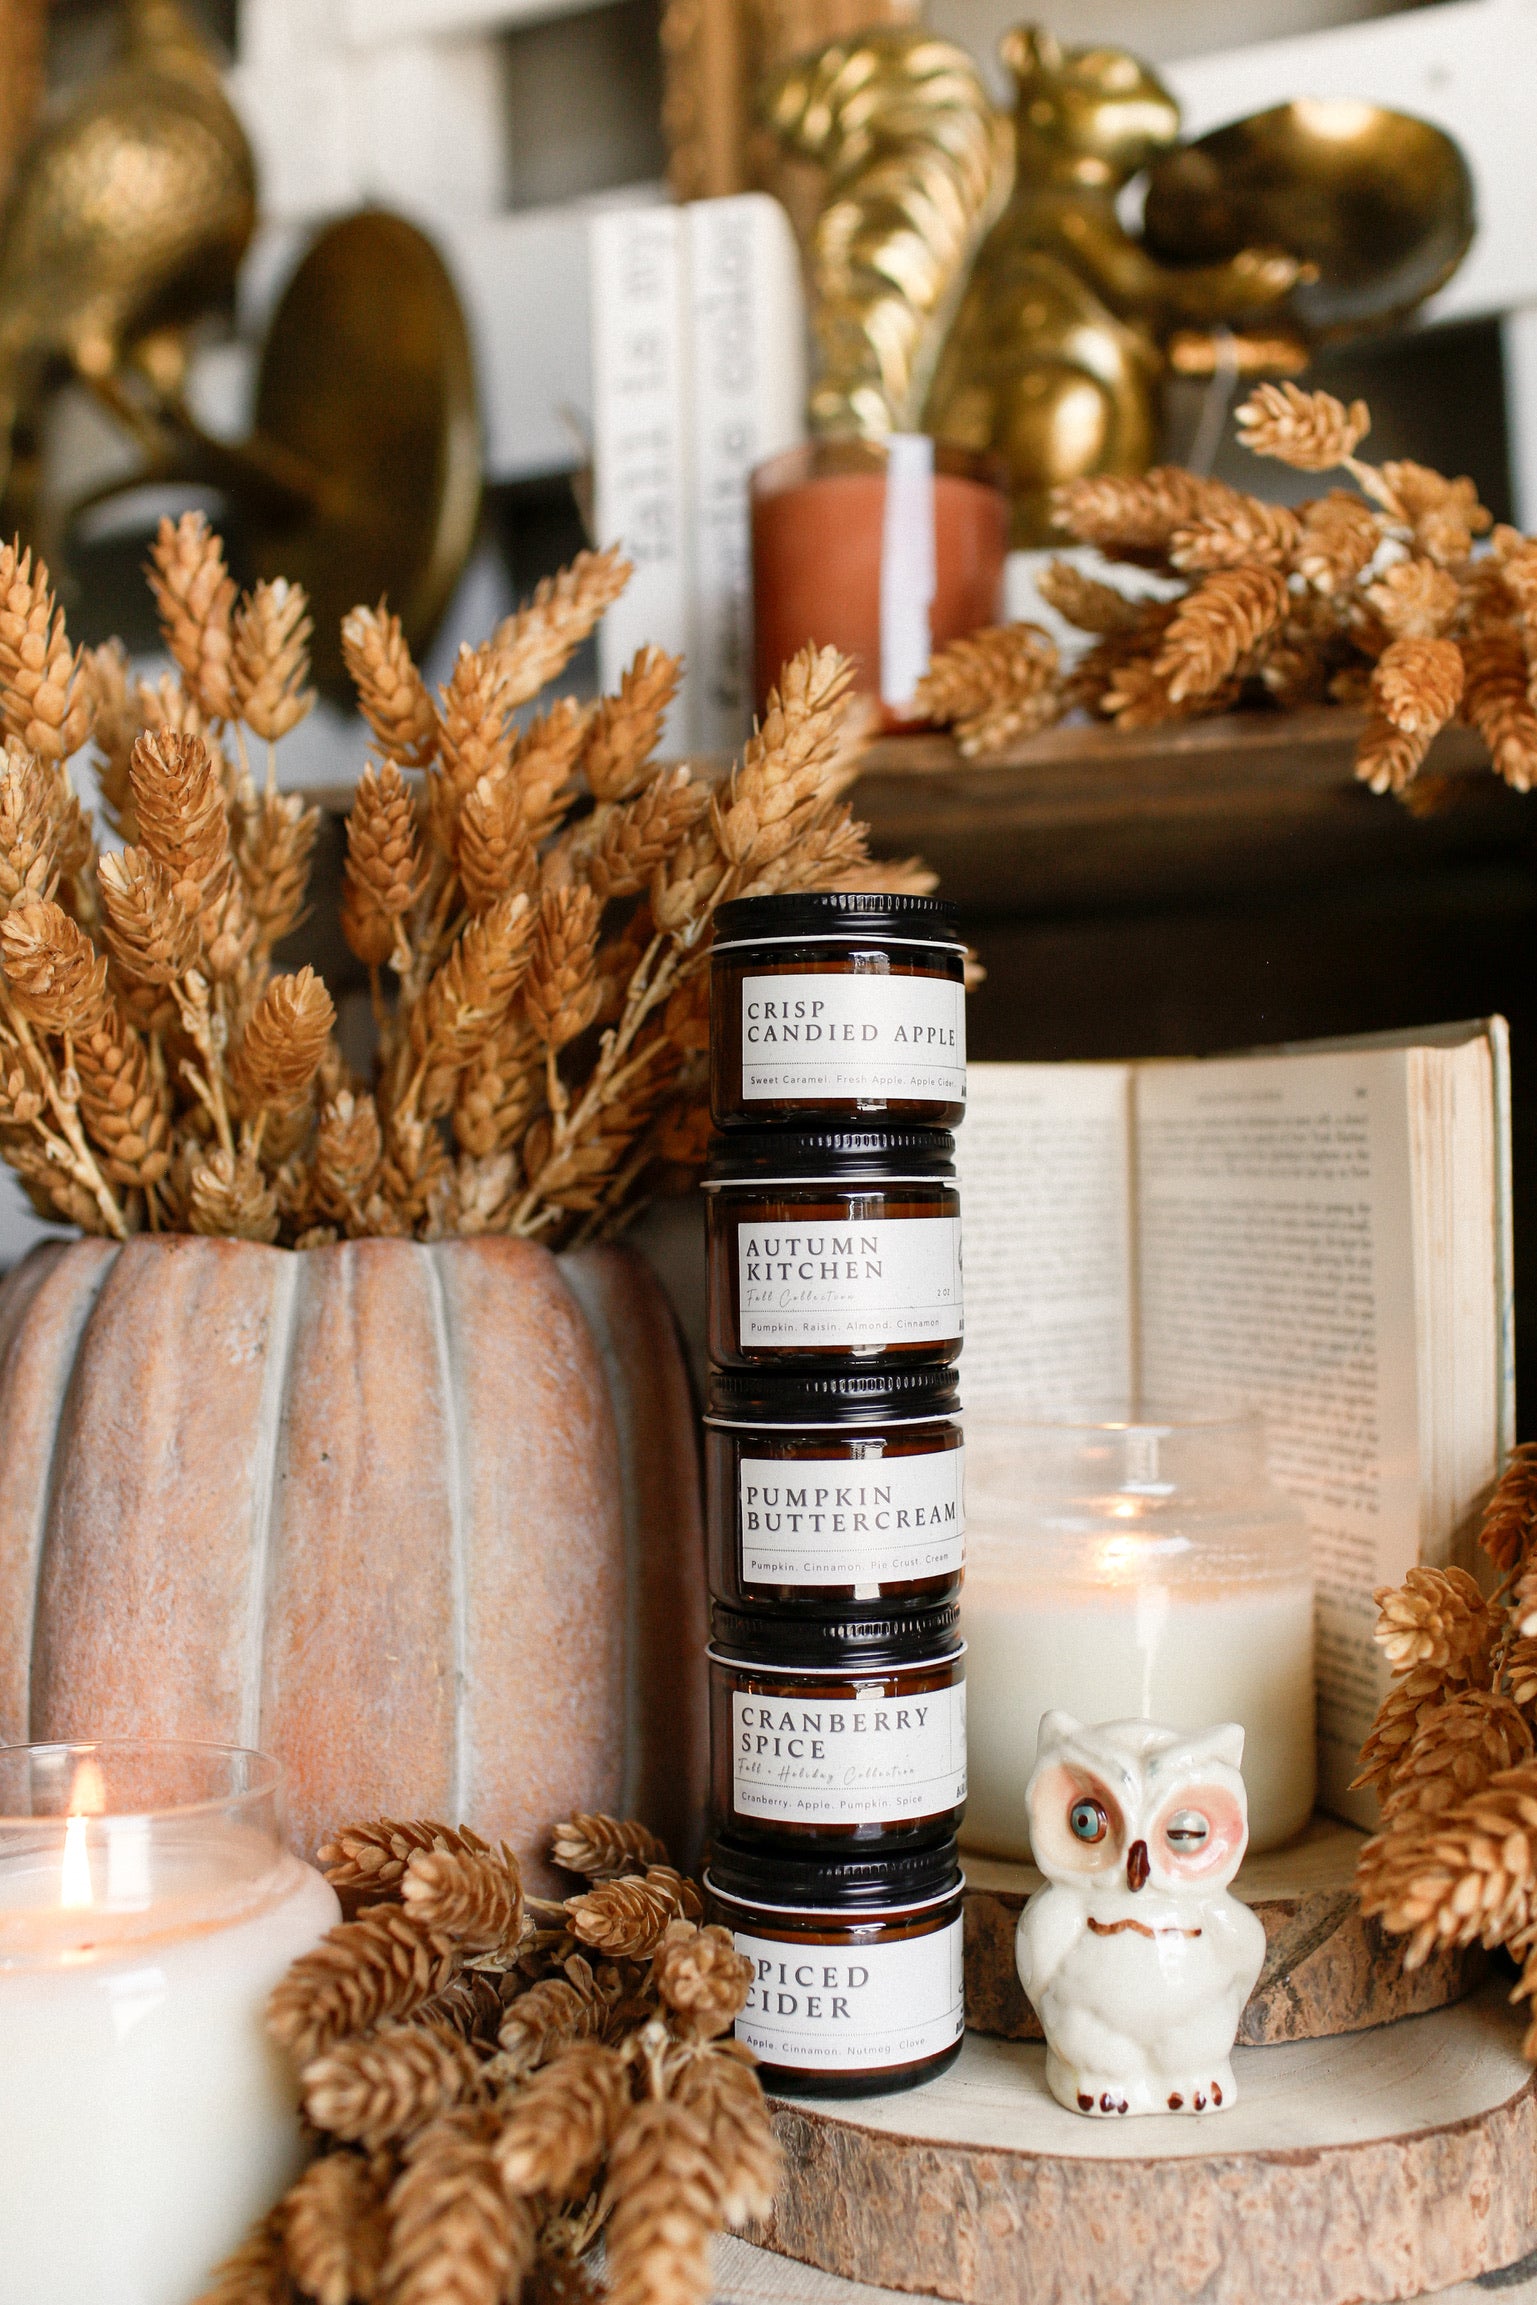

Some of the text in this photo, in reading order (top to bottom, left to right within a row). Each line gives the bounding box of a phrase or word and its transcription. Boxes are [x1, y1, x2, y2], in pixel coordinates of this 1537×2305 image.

[747, 1001, 825, 1020] CRISP
[747, 1024, 955, 1046] CANDIED APPLE
[751, 1076, 778, 1085] Sweet
[837, 1075, 867, 1084] Fresh
[910, 1076, 935, 1087] Apple
[746, 1237, 879, 1257] AUTUMN
[747, 1260, 883, 1281] KITCHEN
[747, 1288, 855, 1308] Fall Collection
[896, 1319, 939, 1330] Cinnamon
[747, 1486, 892, 1507] PUMPKIN
[747, 1501, 956, 1532] BUTTERCREAM
[925, 1552, 949, 1563] Cream
[742, 1707, 928, 1733] CRANBERRY
[742, 1733, 825, 1759] SPICE
[738, 1757, 914, 1785] Fall Holiday Collection
[896, 1794, 923, 1806] Spice
[746, 1956, 869, 1988] PICED
